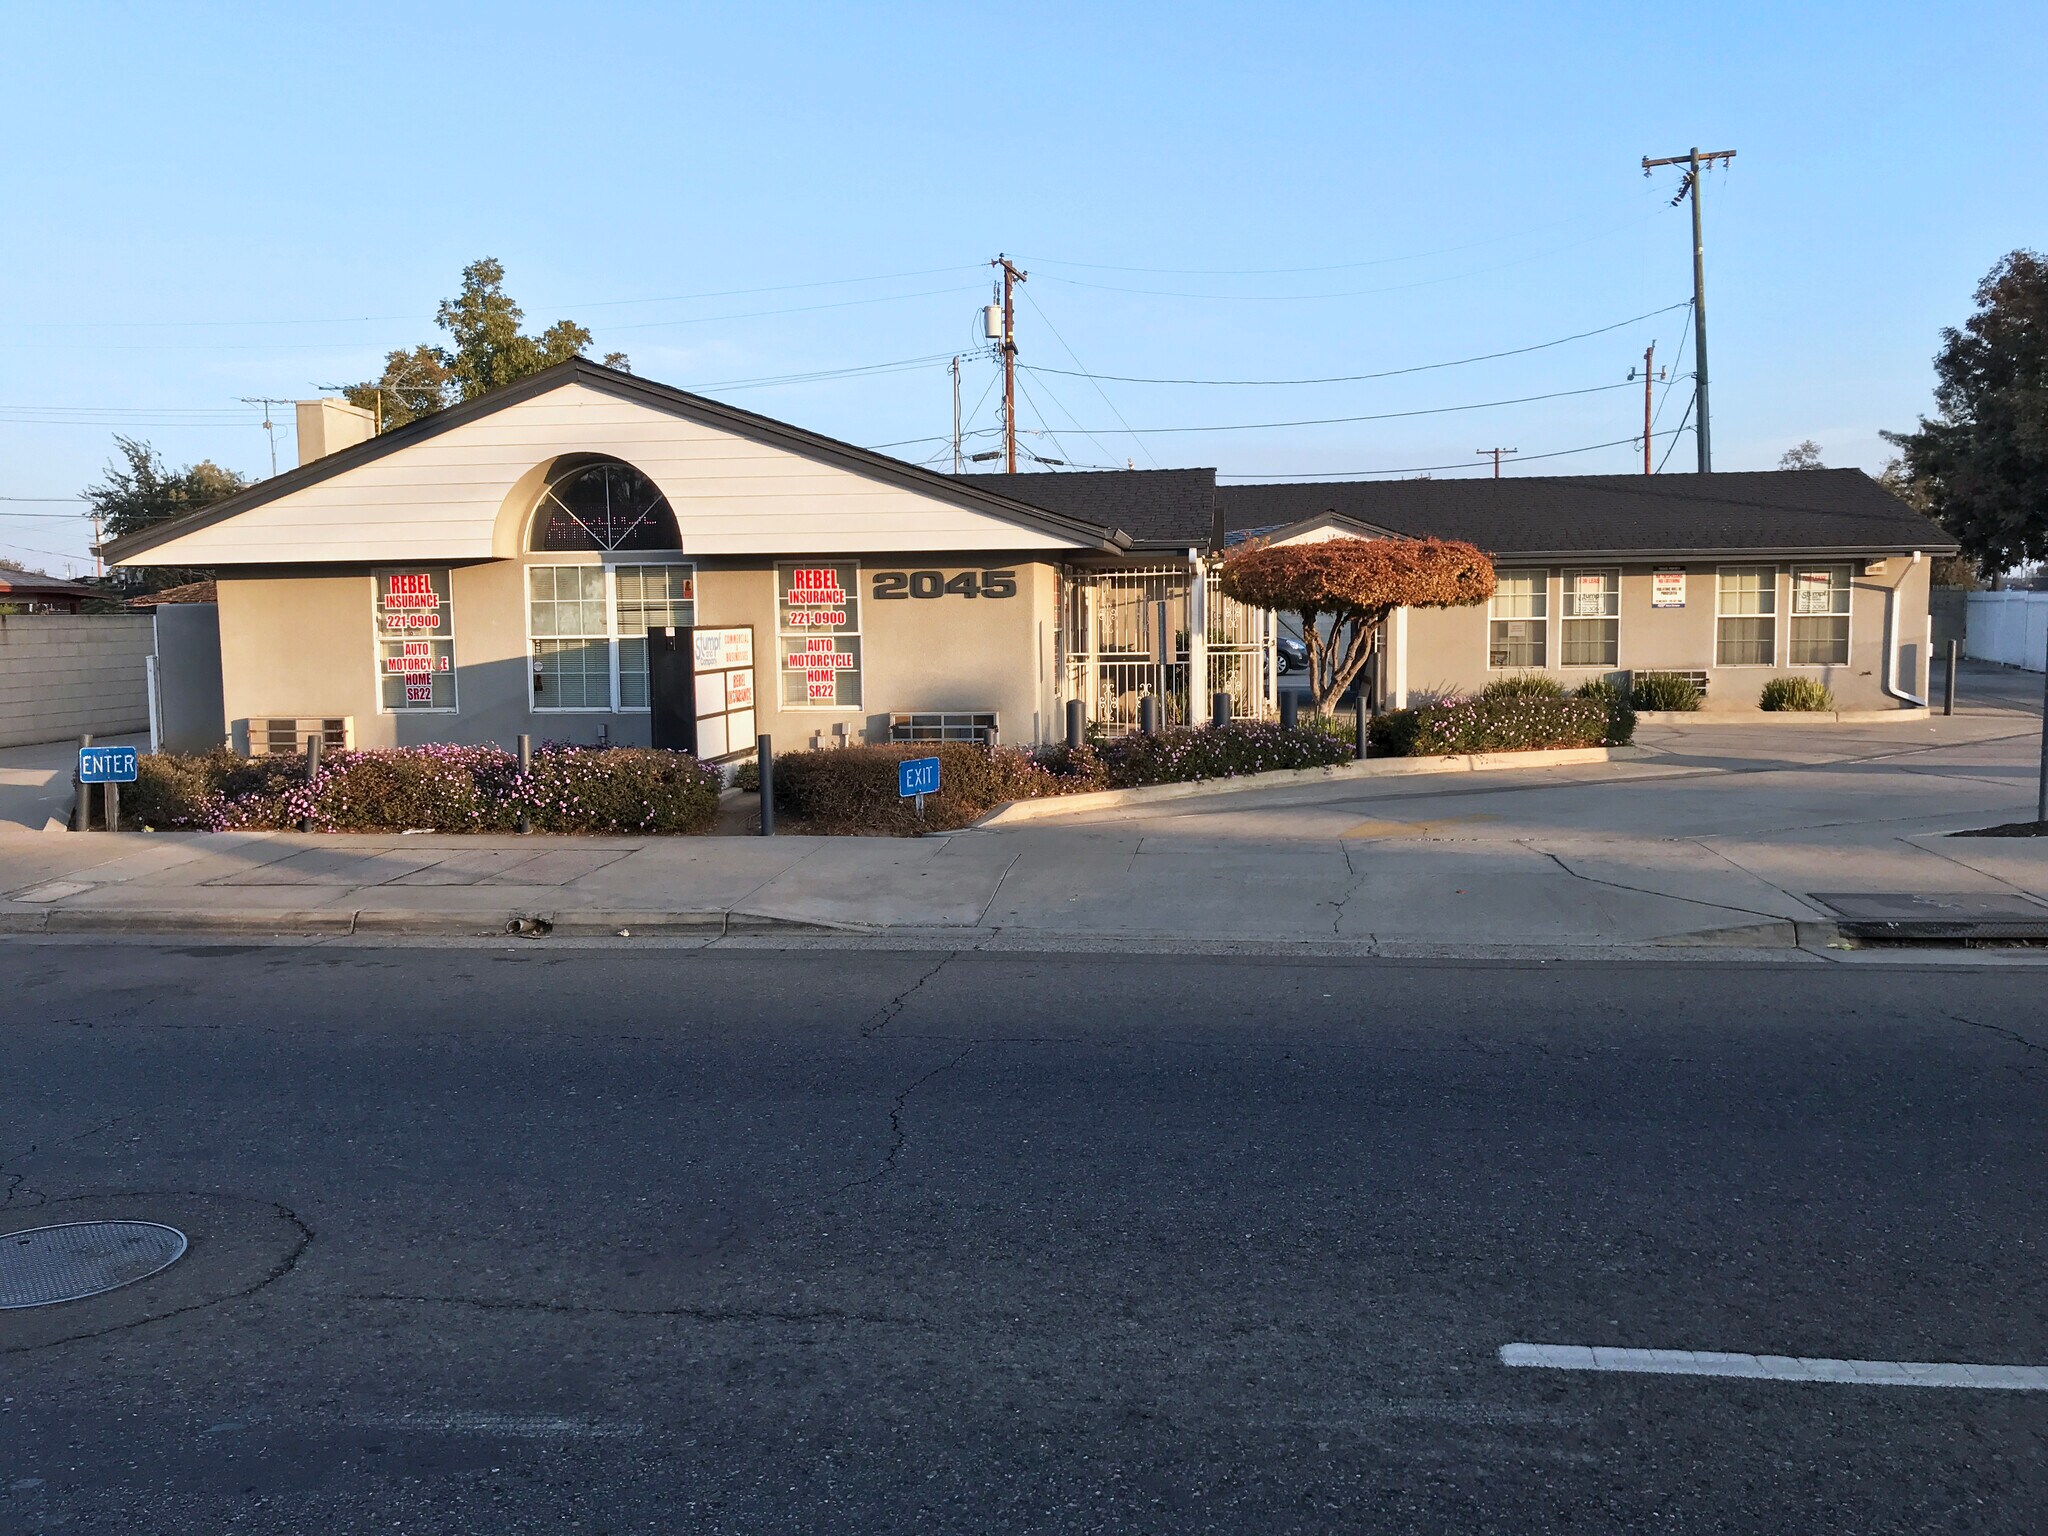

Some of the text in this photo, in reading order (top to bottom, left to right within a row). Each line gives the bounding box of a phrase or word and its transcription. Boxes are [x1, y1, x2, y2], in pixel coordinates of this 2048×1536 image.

[390, 575, 431, 594] REBEL
[794, 570, 838, 590] REBEL
[872, 570, 1017, 600] 2045
[386, 594, 439, 608] INSURANCE
[789, 590, 845, 604] INSURANCE
[387, 614, 440, 628] 221-0900
[790, 611, 846, 625] 221-0900
[695, 632, 721, 660] Stumpf
[724, 634, 749, 645] COMMERCIAL
[807, 639, 833, 652] AUTO
[405, 643, 429, 656] AUTO
[388, 657, 448, 671] MOTORCYE
[789, 654, 852, 667] MOTORCYCLE
[405, 673, 432, 686] HOME
[807, 669, 834, 683] HOME
[407, 687, 431, 700] SR22
[809, 684, 834, 697] SR22
[82, 754, 135, 775] ENTER
[906, 765, 933, 788] EXIT
